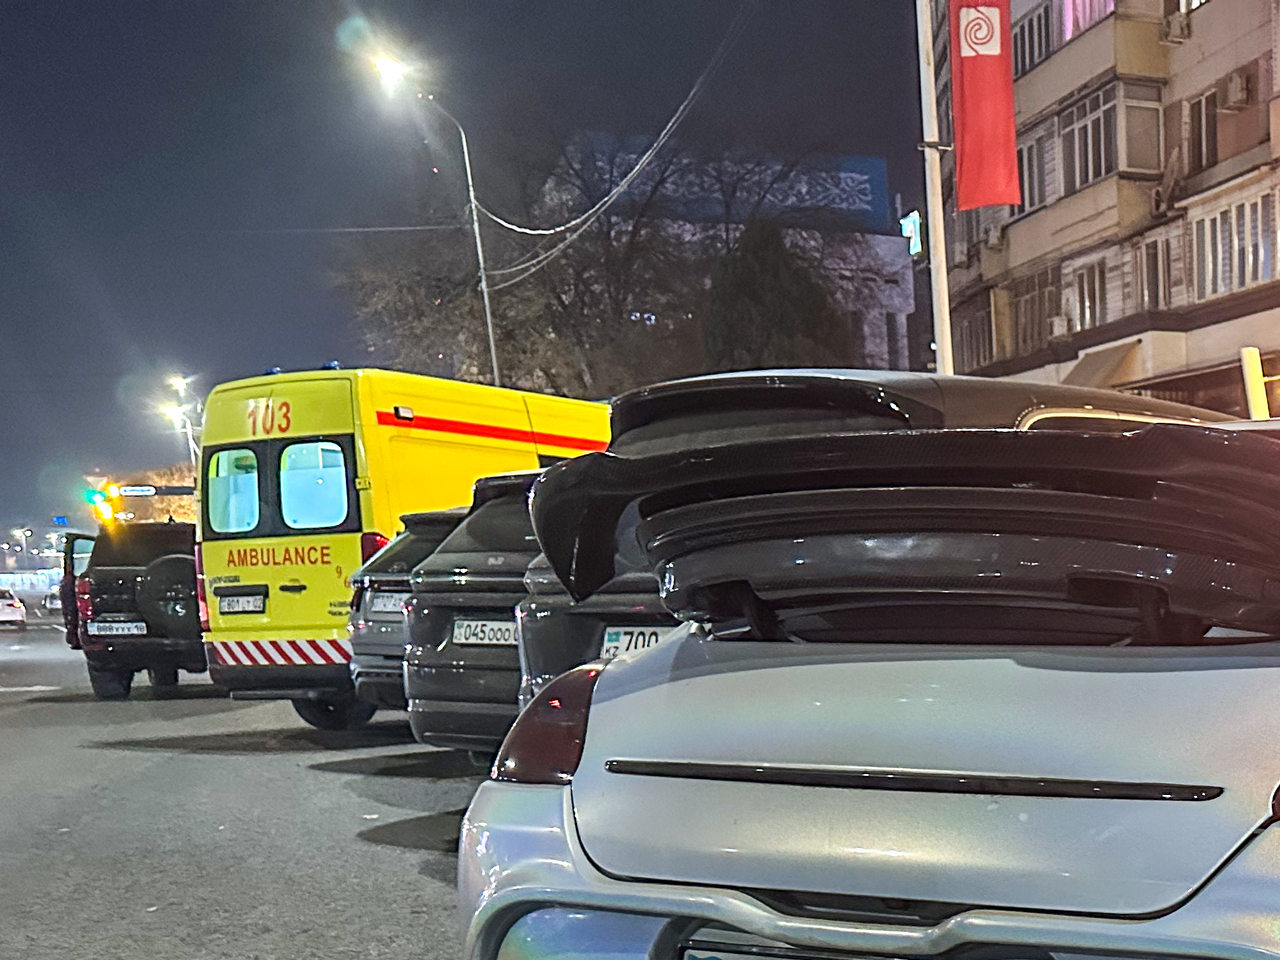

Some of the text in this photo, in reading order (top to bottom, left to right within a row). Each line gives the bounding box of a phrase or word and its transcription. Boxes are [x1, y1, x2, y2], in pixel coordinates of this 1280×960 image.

[248, 401, 290, 436] 103
[227, 546, 331, 567] AMBULANCE
[605, 646, 619, 657] KZ
